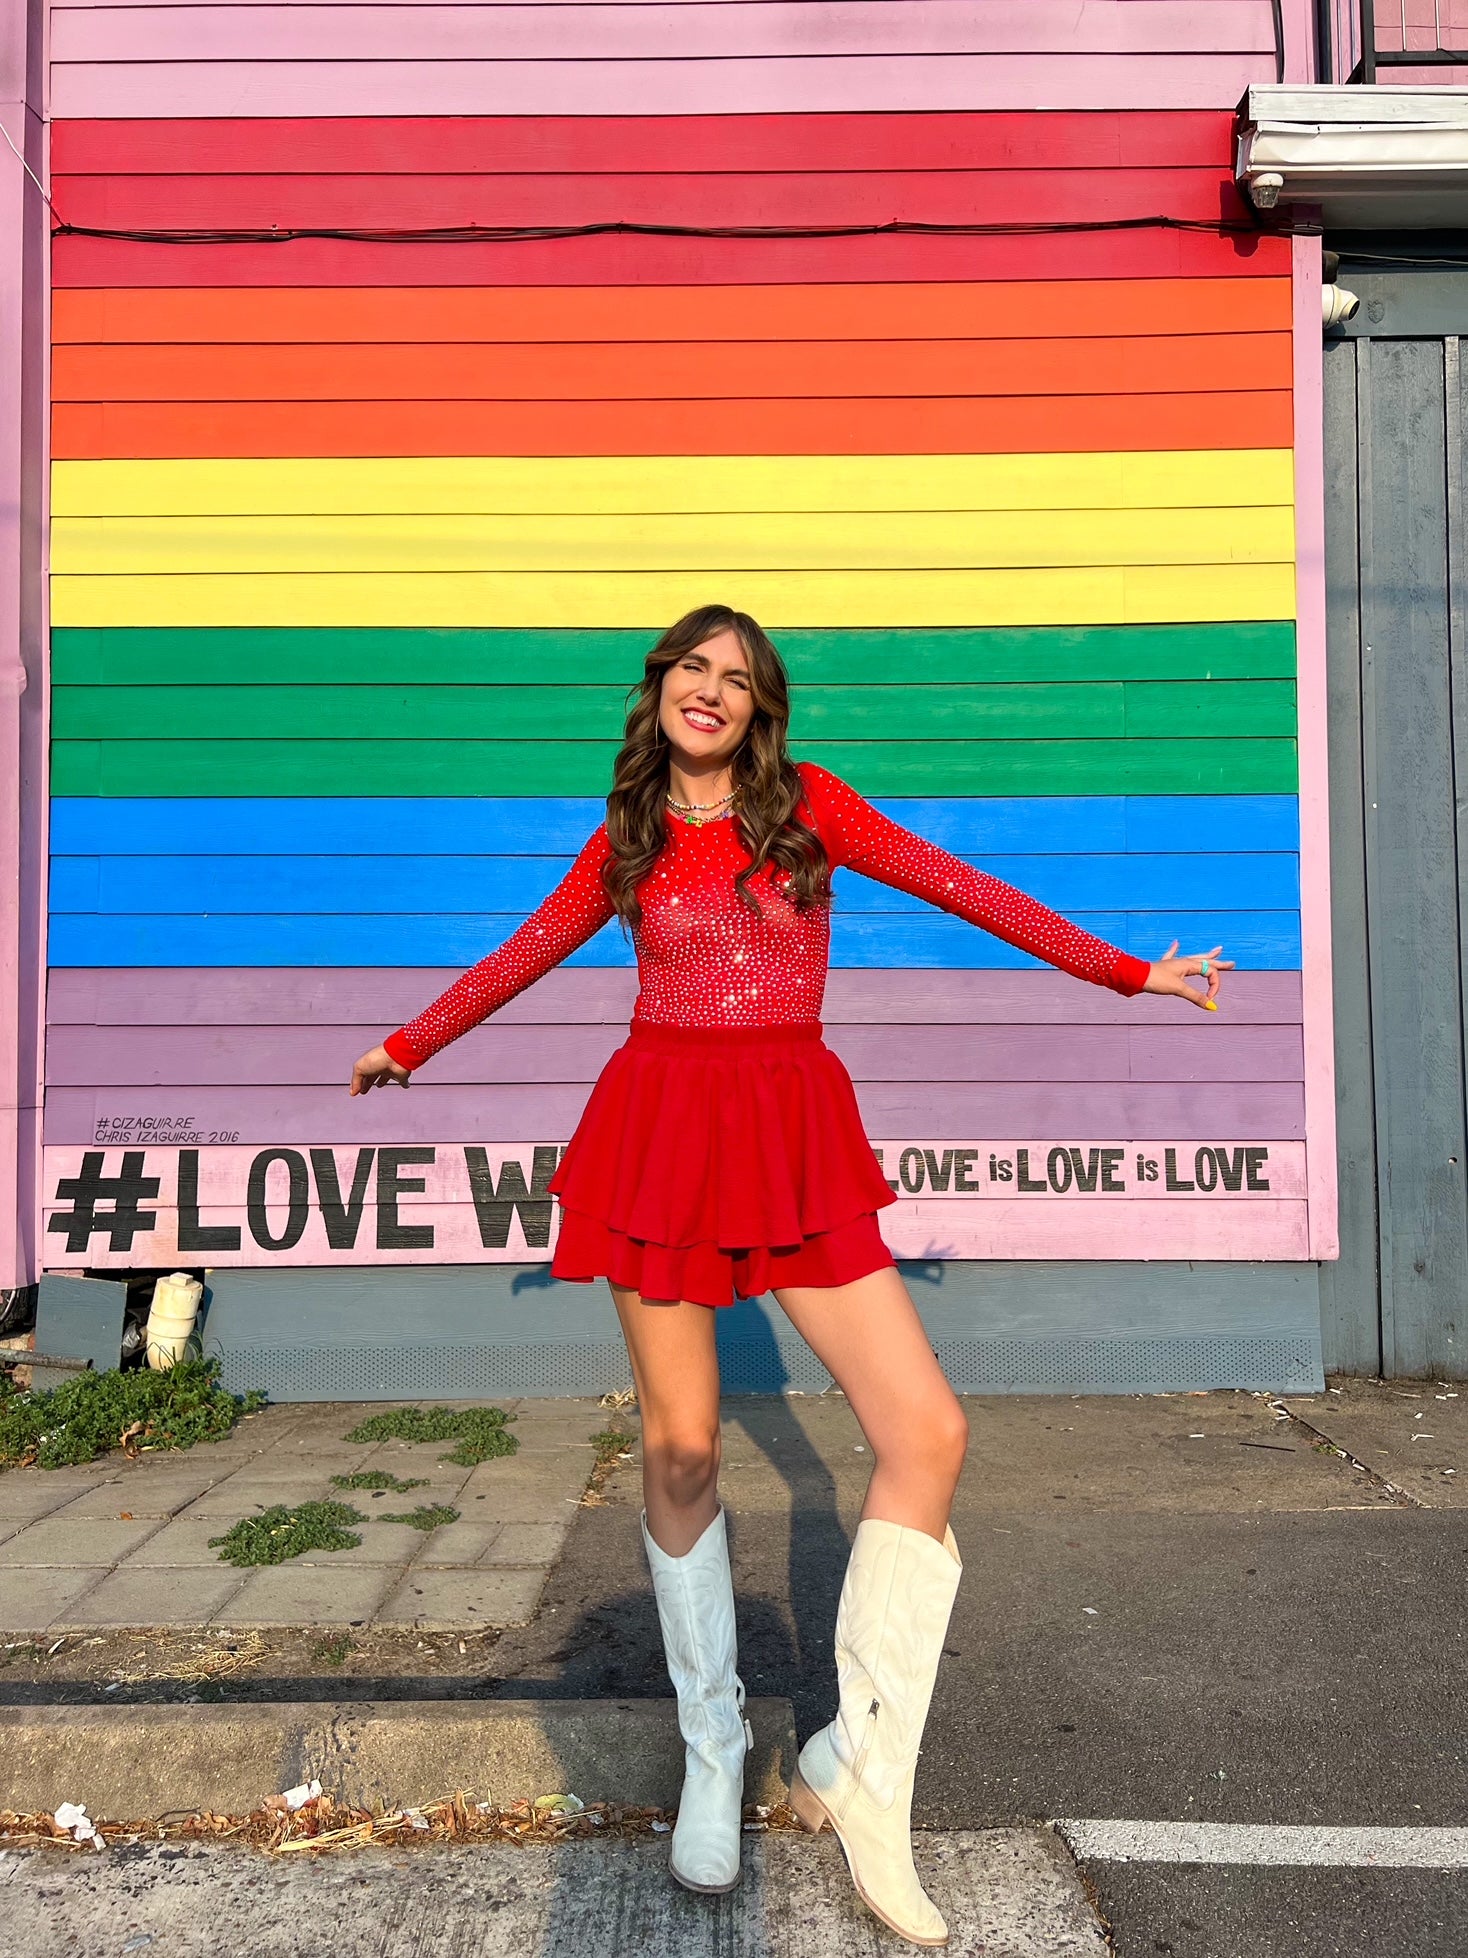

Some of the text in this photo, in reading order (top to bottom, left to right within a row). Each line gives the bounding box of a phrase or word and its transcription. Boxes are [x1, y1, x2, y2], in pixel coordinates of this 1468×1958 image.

[95, 1130, 240, 1143] CHRIS IZAGUIRRE 2016
[989, 1153, 1013, 1182] is
[1017, 1147, 1125, 1193] LOVE
[1136, 1153, 1159, 1182] is
[1165, 1147, 1269, 1192] LOVE
[463, 1146, 567, 1248] W
